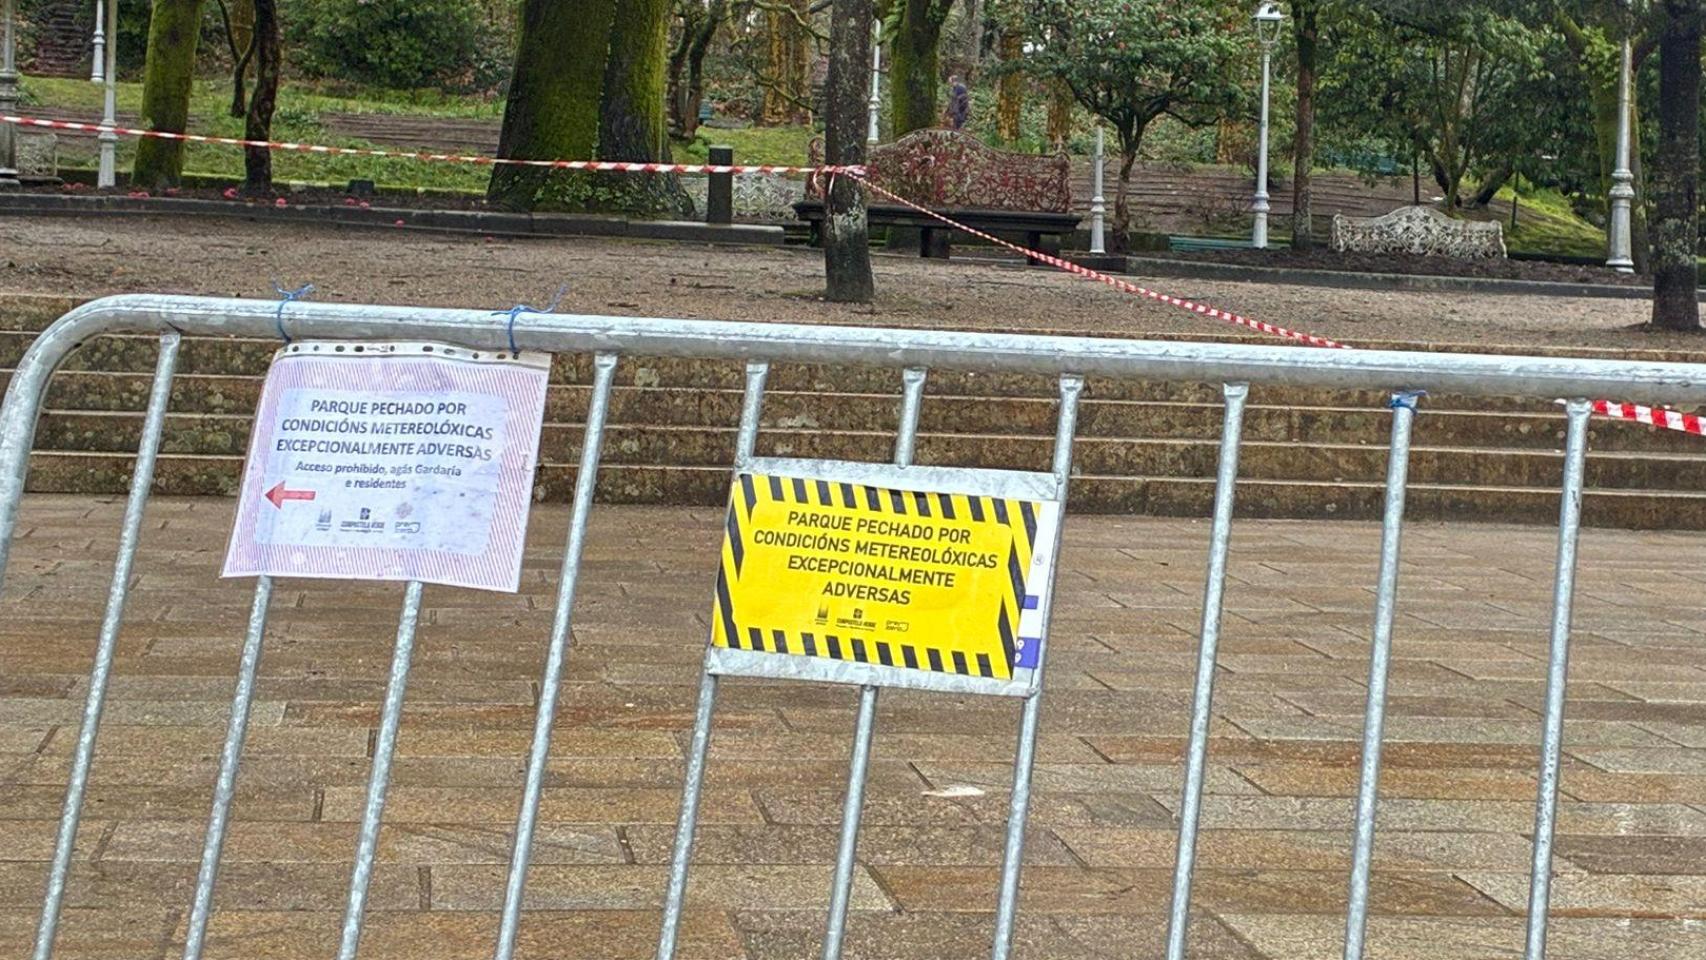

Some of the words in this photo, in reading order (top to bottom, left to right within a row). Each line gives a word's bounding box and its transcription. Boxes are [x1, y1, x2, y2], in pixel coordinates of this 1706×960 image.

[310, 400, 367, 414] PARQUE
[370, 402, 435, 416] PECHADO
[437, 403, 466, 416] POR
[282, 417, 368, 434] CONDICIÓNS
[371, 420, 493, 440] METEREOLÓXICAS
[276, 439, 415, 456] EXCEPCIONALMENTE
[417, 443, 492, 461] ADVERSAS
[295, 461, 333, 472] Acceso
[334, 463, 388, 475] prohibido,
[345, 480, 352, 488] e
[353, 477, 406, 489] residentes
[788, 511, 852, 532] PARQUE
[856, 519, 934, 540] PECHADO
[938, 527, 971, 545] POR
[754, 530, 851, 553] CONDICIÓNS
[854, 540, 998, 569] METEREOLÓXICAS
[788, 555, 956, 588] EXCEPCIONALMENTE
[822, 582, 911, 605] ADVERSAS
